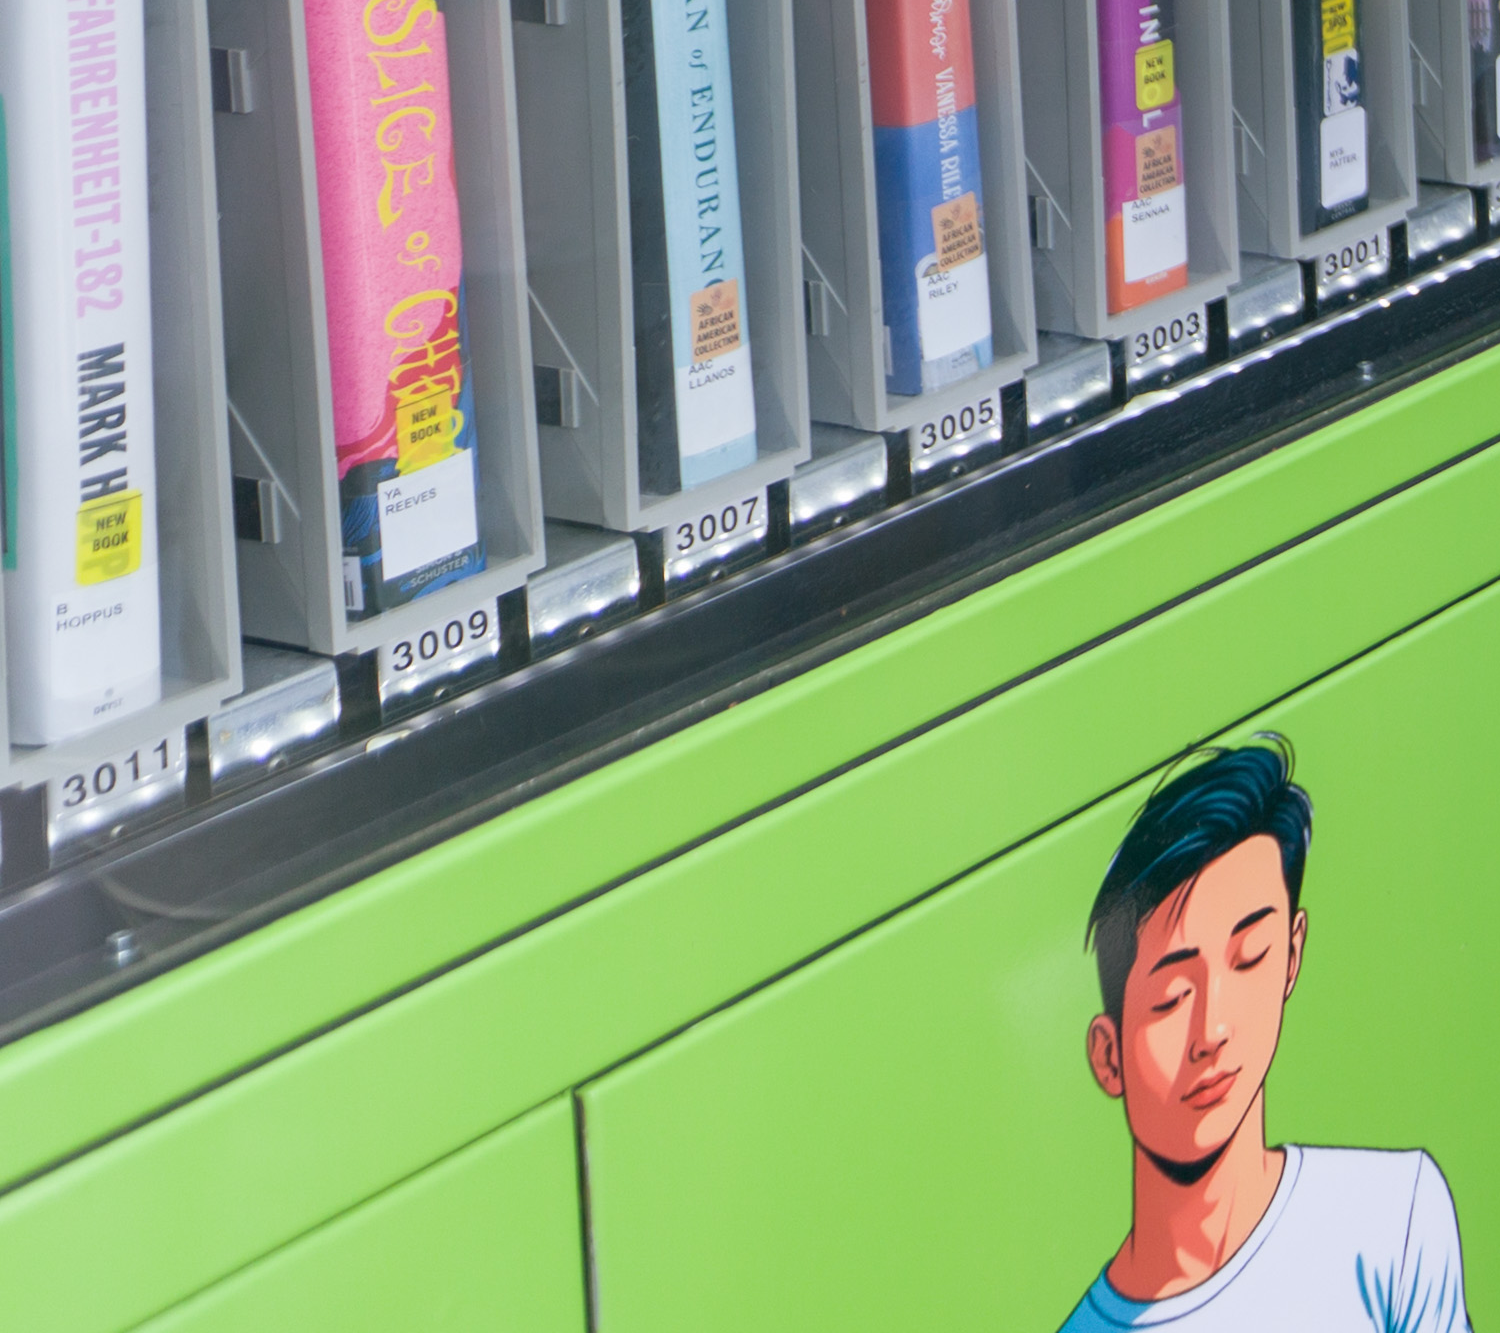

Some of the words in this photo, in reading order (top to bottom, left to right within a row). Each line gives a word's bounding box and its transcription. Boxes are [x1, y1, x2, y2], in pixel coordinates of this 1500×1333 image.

[1138, 4, 1161, 44] IN
[687, 49, 707, 70] of
[1145, 54, 1163, 69] NEW
[1143, 69, 1166, 85] BOOK
[935, 68, 962, 154] VANESSA
[1143, 153, 1171, 169] AFRICAN
[690, 83, 727, 289] ENDURAN
[941, 156, 962, 200] RILE
[1140, 175, 1176, 194] COLLECTION
[940, 232, 979, 256] AMERICAN
[942, 222, 974, 244] AFRICAN
[939, 243, 980, 268] COLLECTION
[1325, 234, 1380, 278] 3001
[928, 280, 959, 300] RILEY
[698, 313, 735, 330] AFRICAN
[694, 333, 740, 357] COLLECTION
[696, 323, 738, 345] AMERICAN
[1134, 312, 1200, 358] 3003
[688, 360, 714, 376] AAC
[689, 365, 735, 390] LLANOS
[78, 342, 127, 469] MARK
[411, 405, 438, 424] NEW
[410, 423, 441, 444] BOOK
[920, 398, 994, 451] 3005
[384, 487, 402, 501] YA
[385, 487, 437, 515] REEVES
[96, 510, 127, 532] NEW
[676, 496, 760, 553] 3007
[92, 530, 130, 552] BOOK
[57, 603, 68, 615] B
[57, 602, 123, 632] HOPPUS
[392, 609, 489, 673] 3009
[63, 739, 169, 808] 3011
